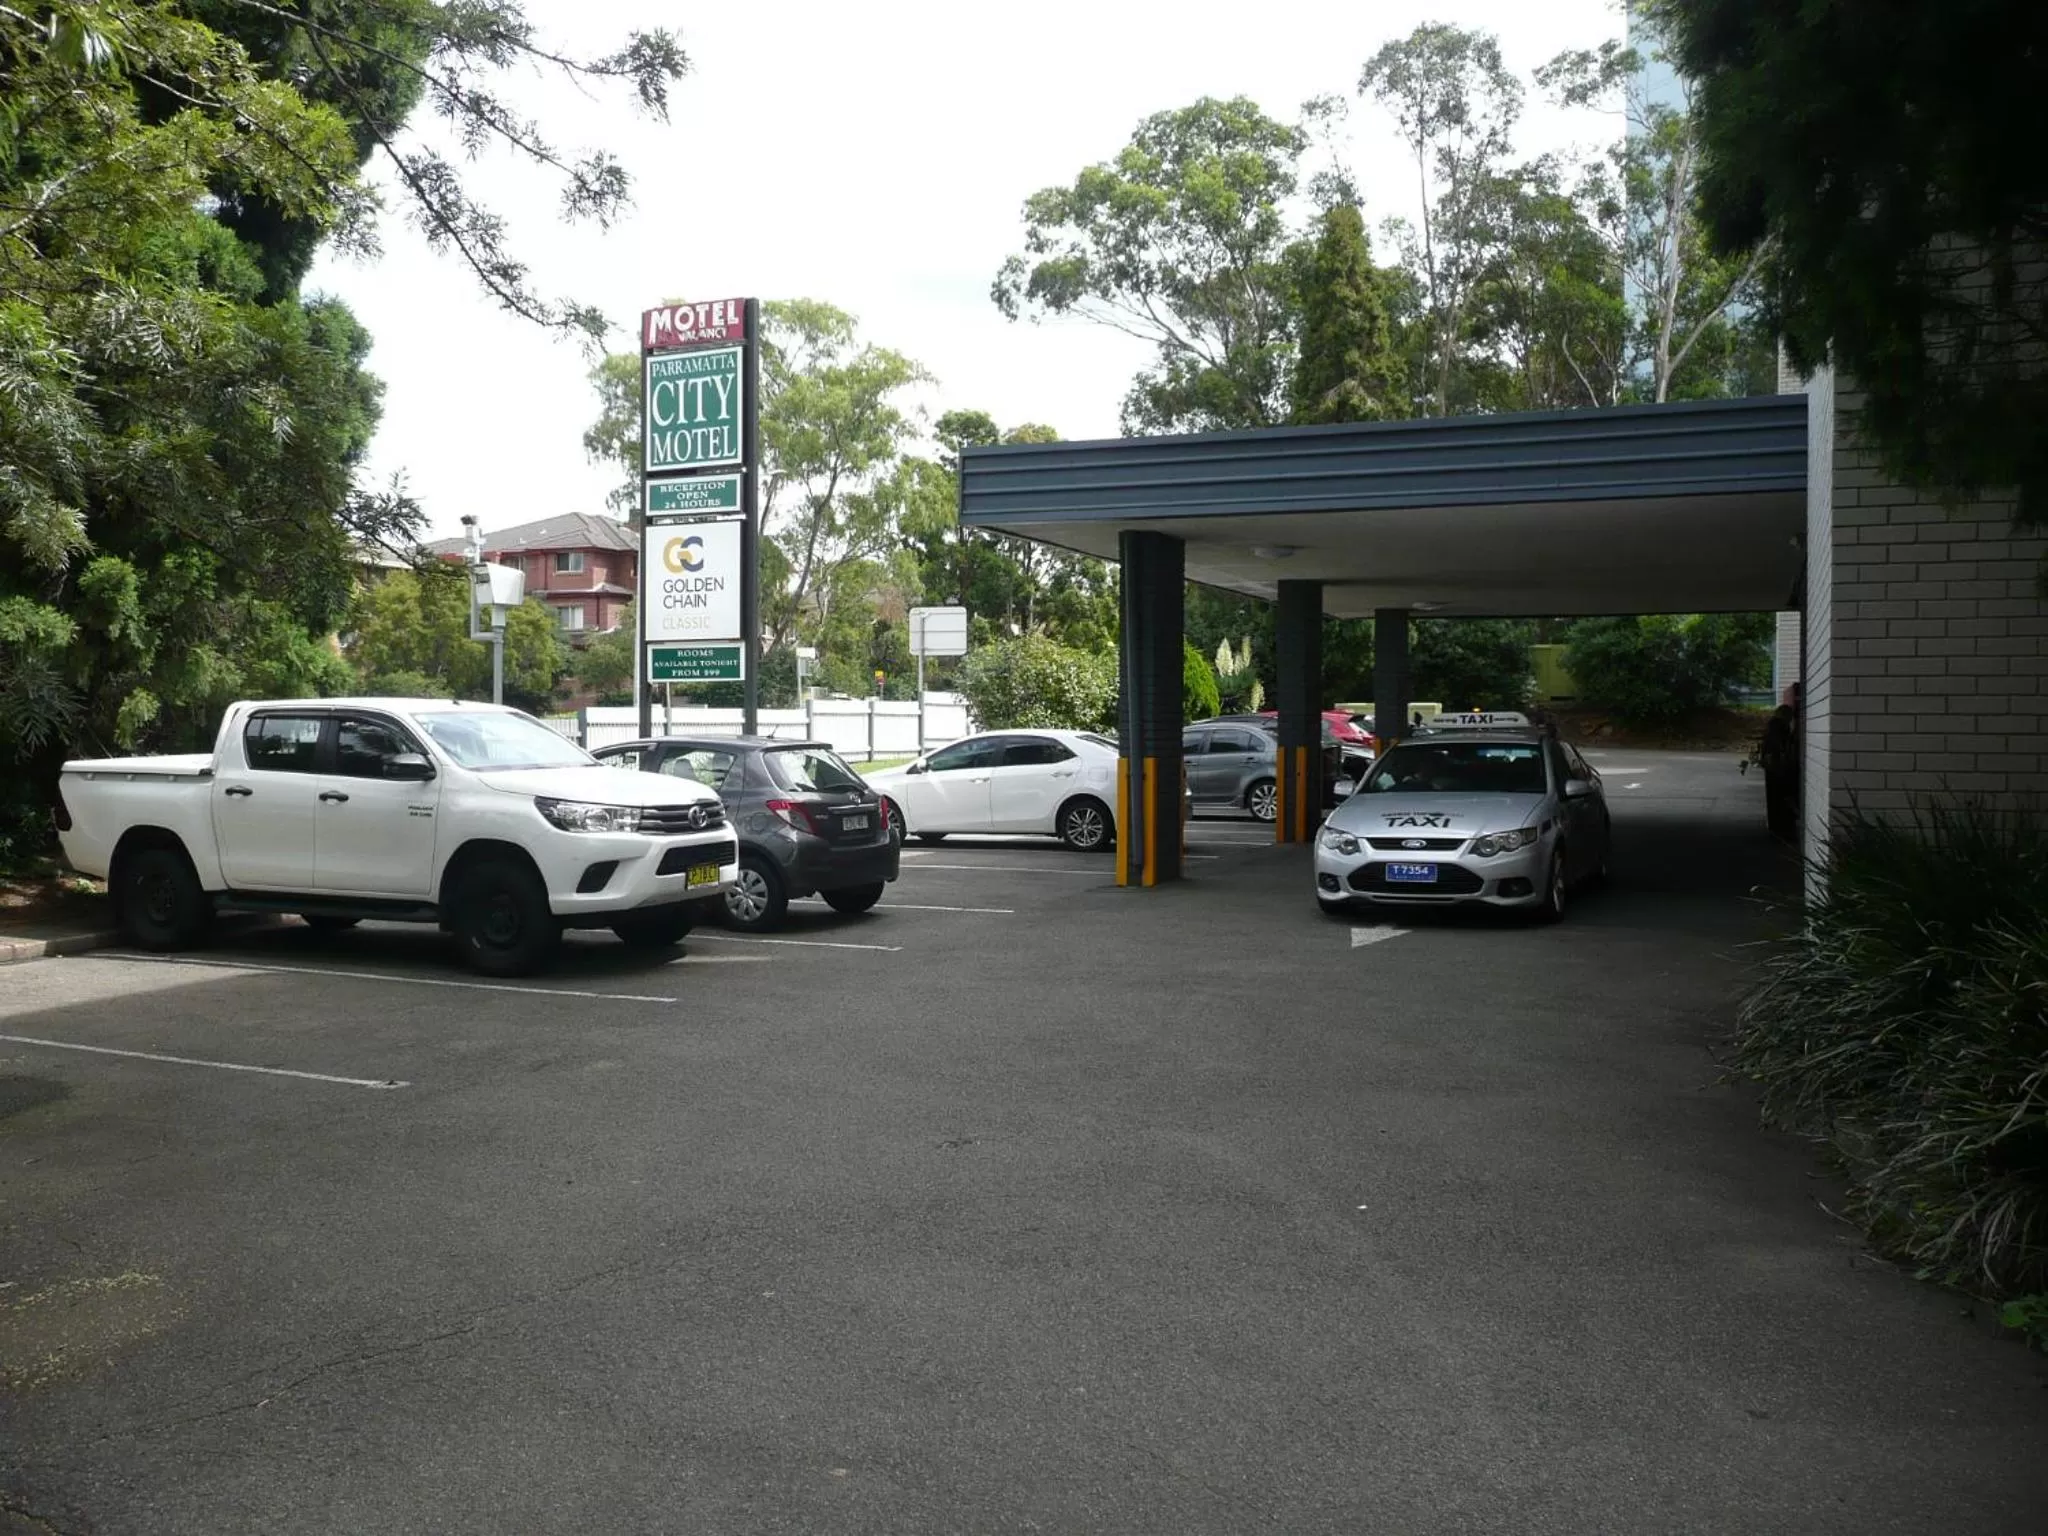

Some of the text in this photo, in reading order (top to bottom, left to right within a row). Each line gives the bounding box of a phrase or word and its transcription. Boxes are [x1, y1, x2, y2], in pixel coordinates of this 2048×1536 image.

[649, 300, 739, 344] MOTEL
[651, 353, 736, 377] PARRAMATTA
[652, 373, 736, 427] CITY
[652, 425, 737, 464] MOTEL
[660, 481, 726, 493] RECEPTION
[677, 491, 708, 501] OPEN
[680, 499, 721, 509] HOURS
[663, 577, 725, 594] GOLDEN
[663, 594, 707, 610] CHAIN
[662, 616, 711, 630] CLASSIC
[654, 659, 737, 668] AVAILABLE TONIGHT
[672, 669, 700, 677] FROM
[1460, 715, 1493, 724] TAXI
[1385, 817, 1451, 828] TAXI
